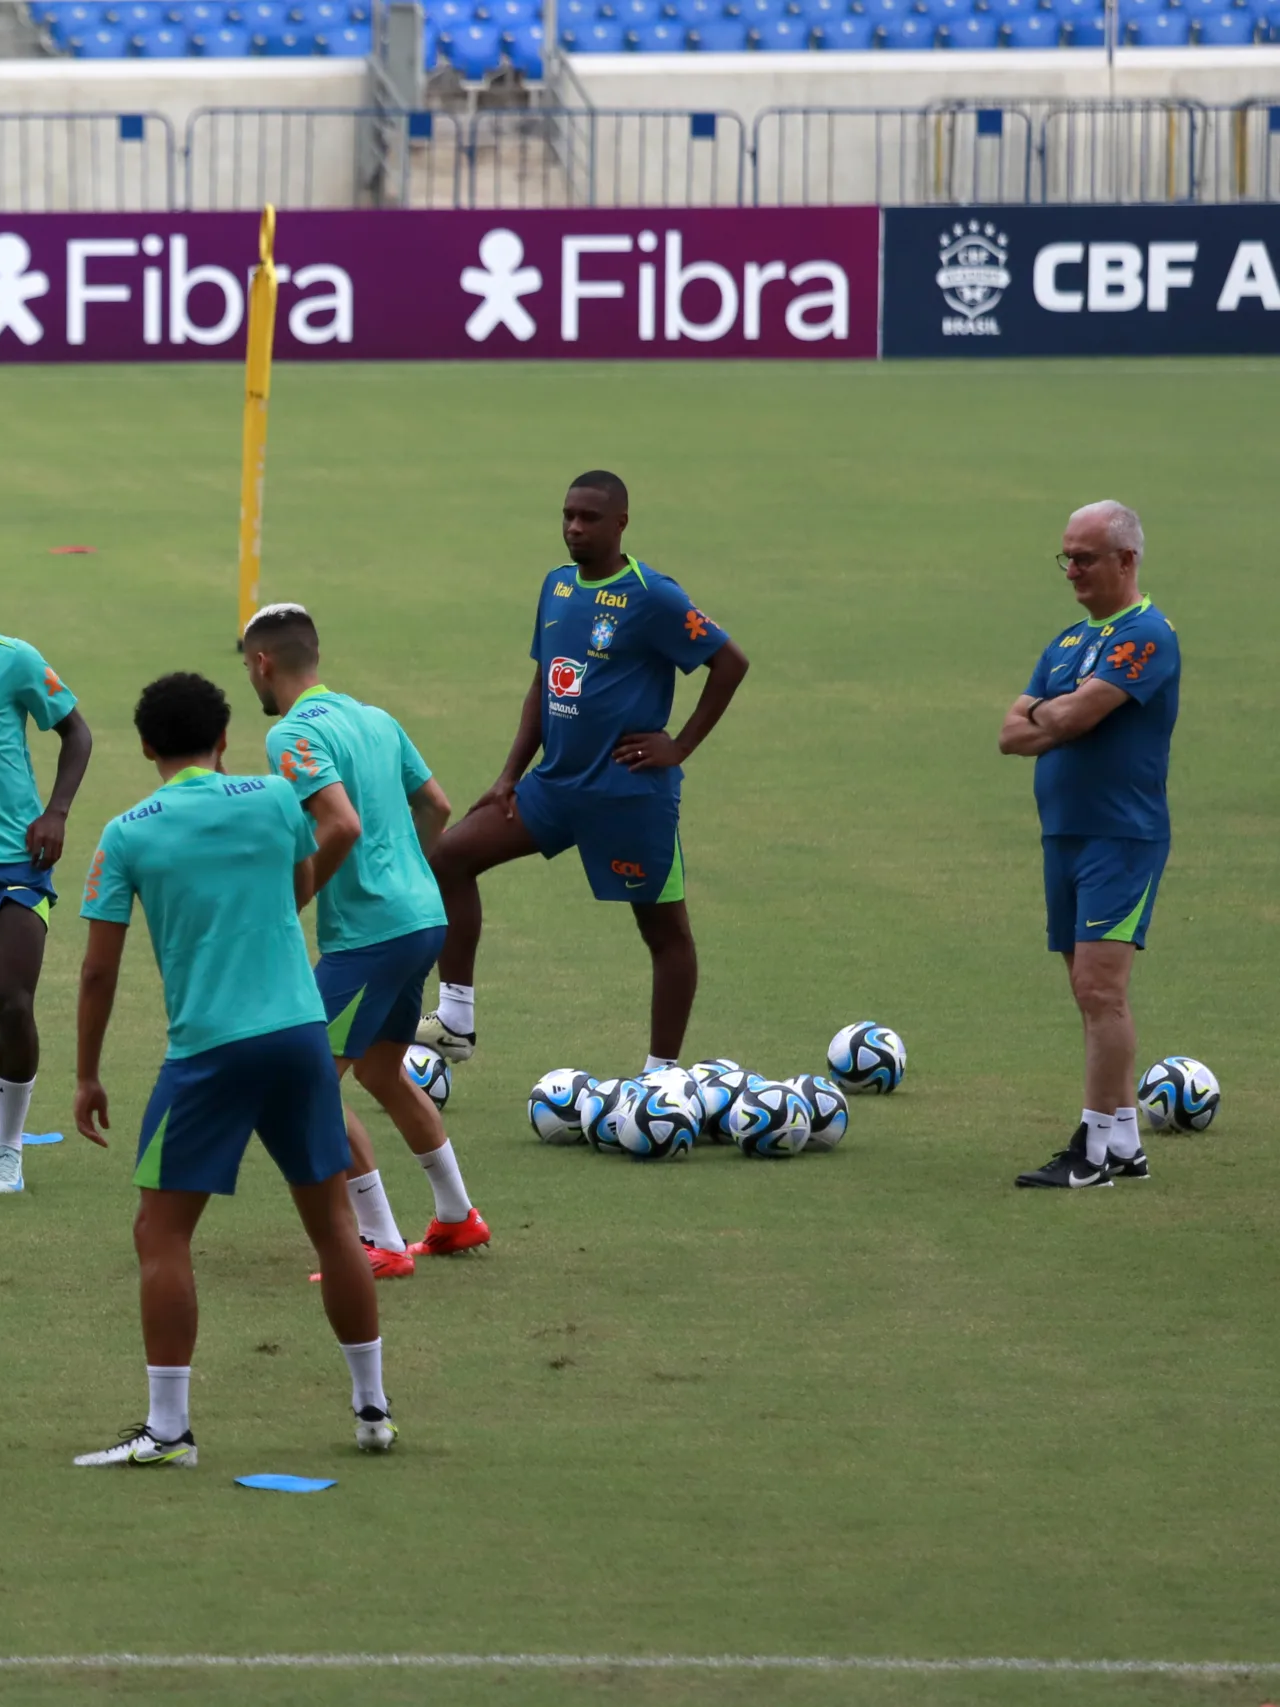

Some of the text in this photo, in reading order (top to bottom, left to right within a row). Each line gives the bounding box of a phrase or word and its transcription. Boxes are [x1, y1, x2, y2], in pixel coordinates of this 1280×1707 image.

[560, 229, 850, 342] Fibra
[1032, 240, 1199, 313] CBF
[942, 316, 1001, 335] BRASIL
[553, 581, 574, 598] Itaú
[594, 590, 628, 609] Itaú
[223, 778, 266, 797] Itaú
[611, 859, 647, 878] GOL
